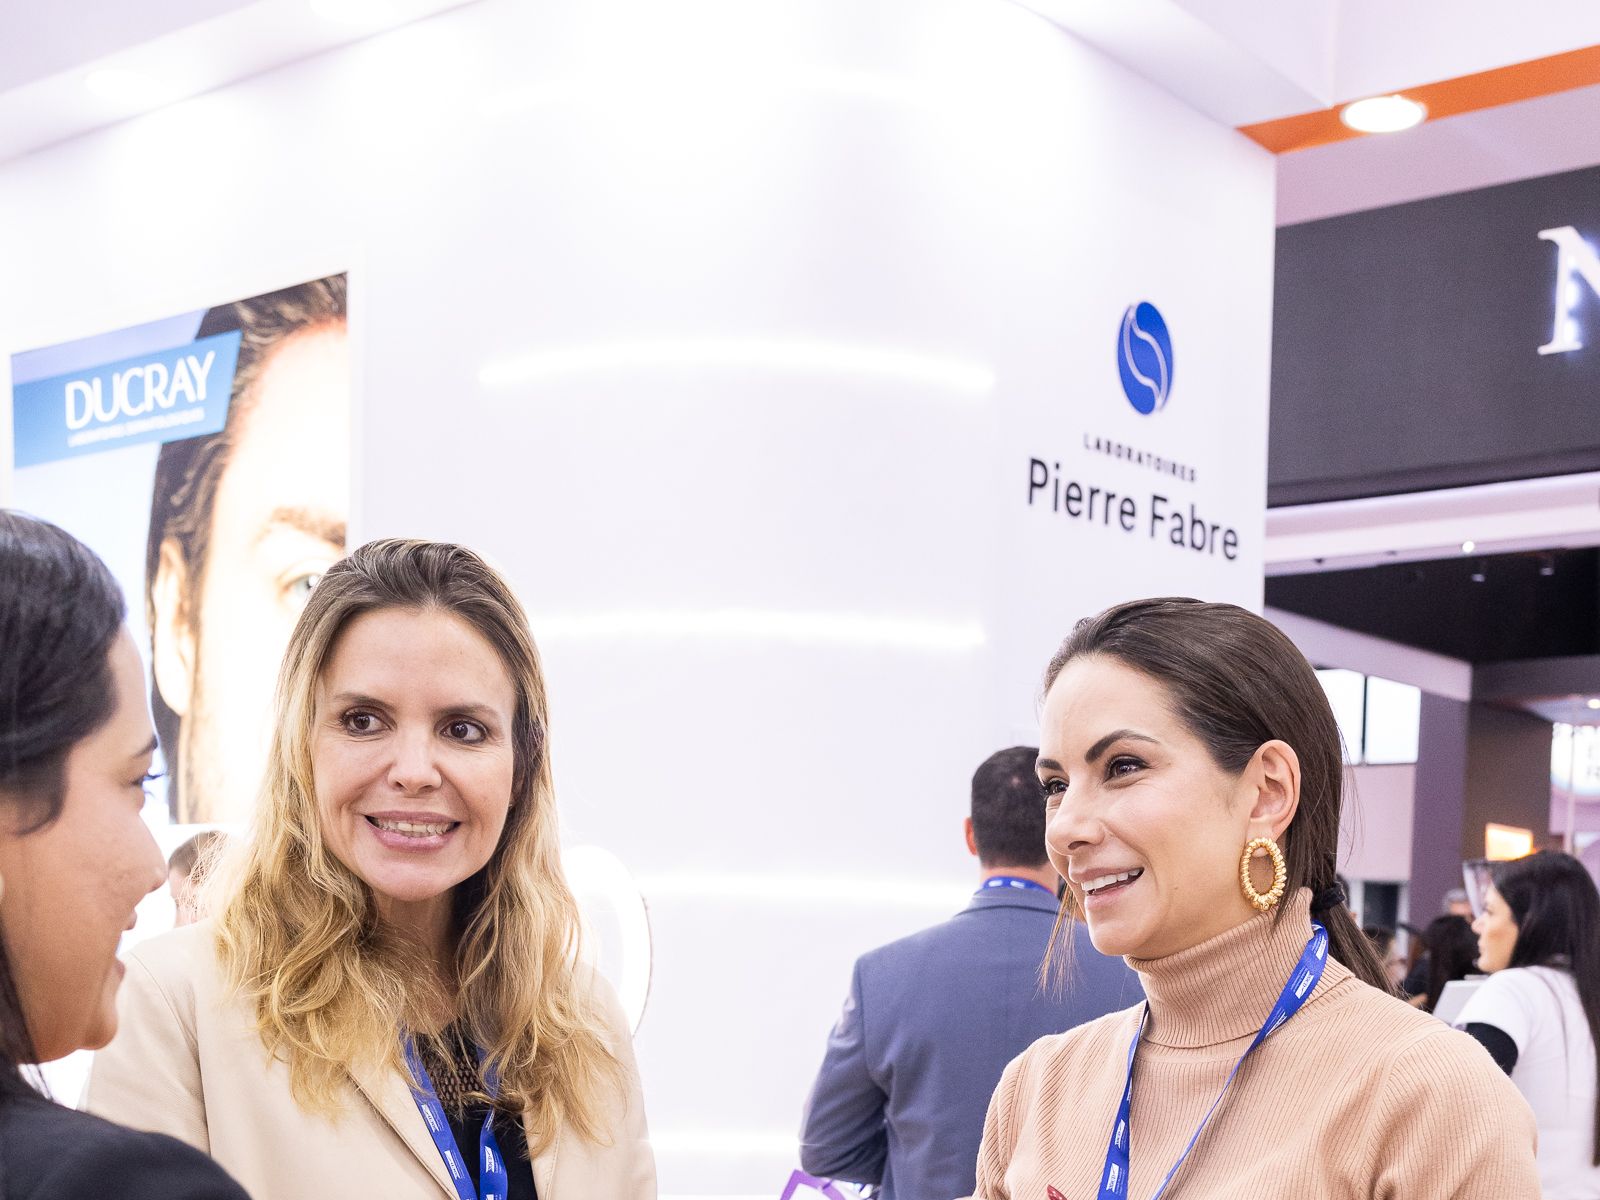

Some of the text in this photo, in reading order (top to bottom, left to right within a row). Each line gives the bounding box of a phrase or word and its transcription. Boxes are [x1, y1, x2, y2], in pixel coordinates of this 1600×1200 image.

[65, 350, 216, 430] DUCRAY
[1083, 433, 1197, 483] LABORATOIRES
[1027, 457, 1239, 561] Pierre Fabre
